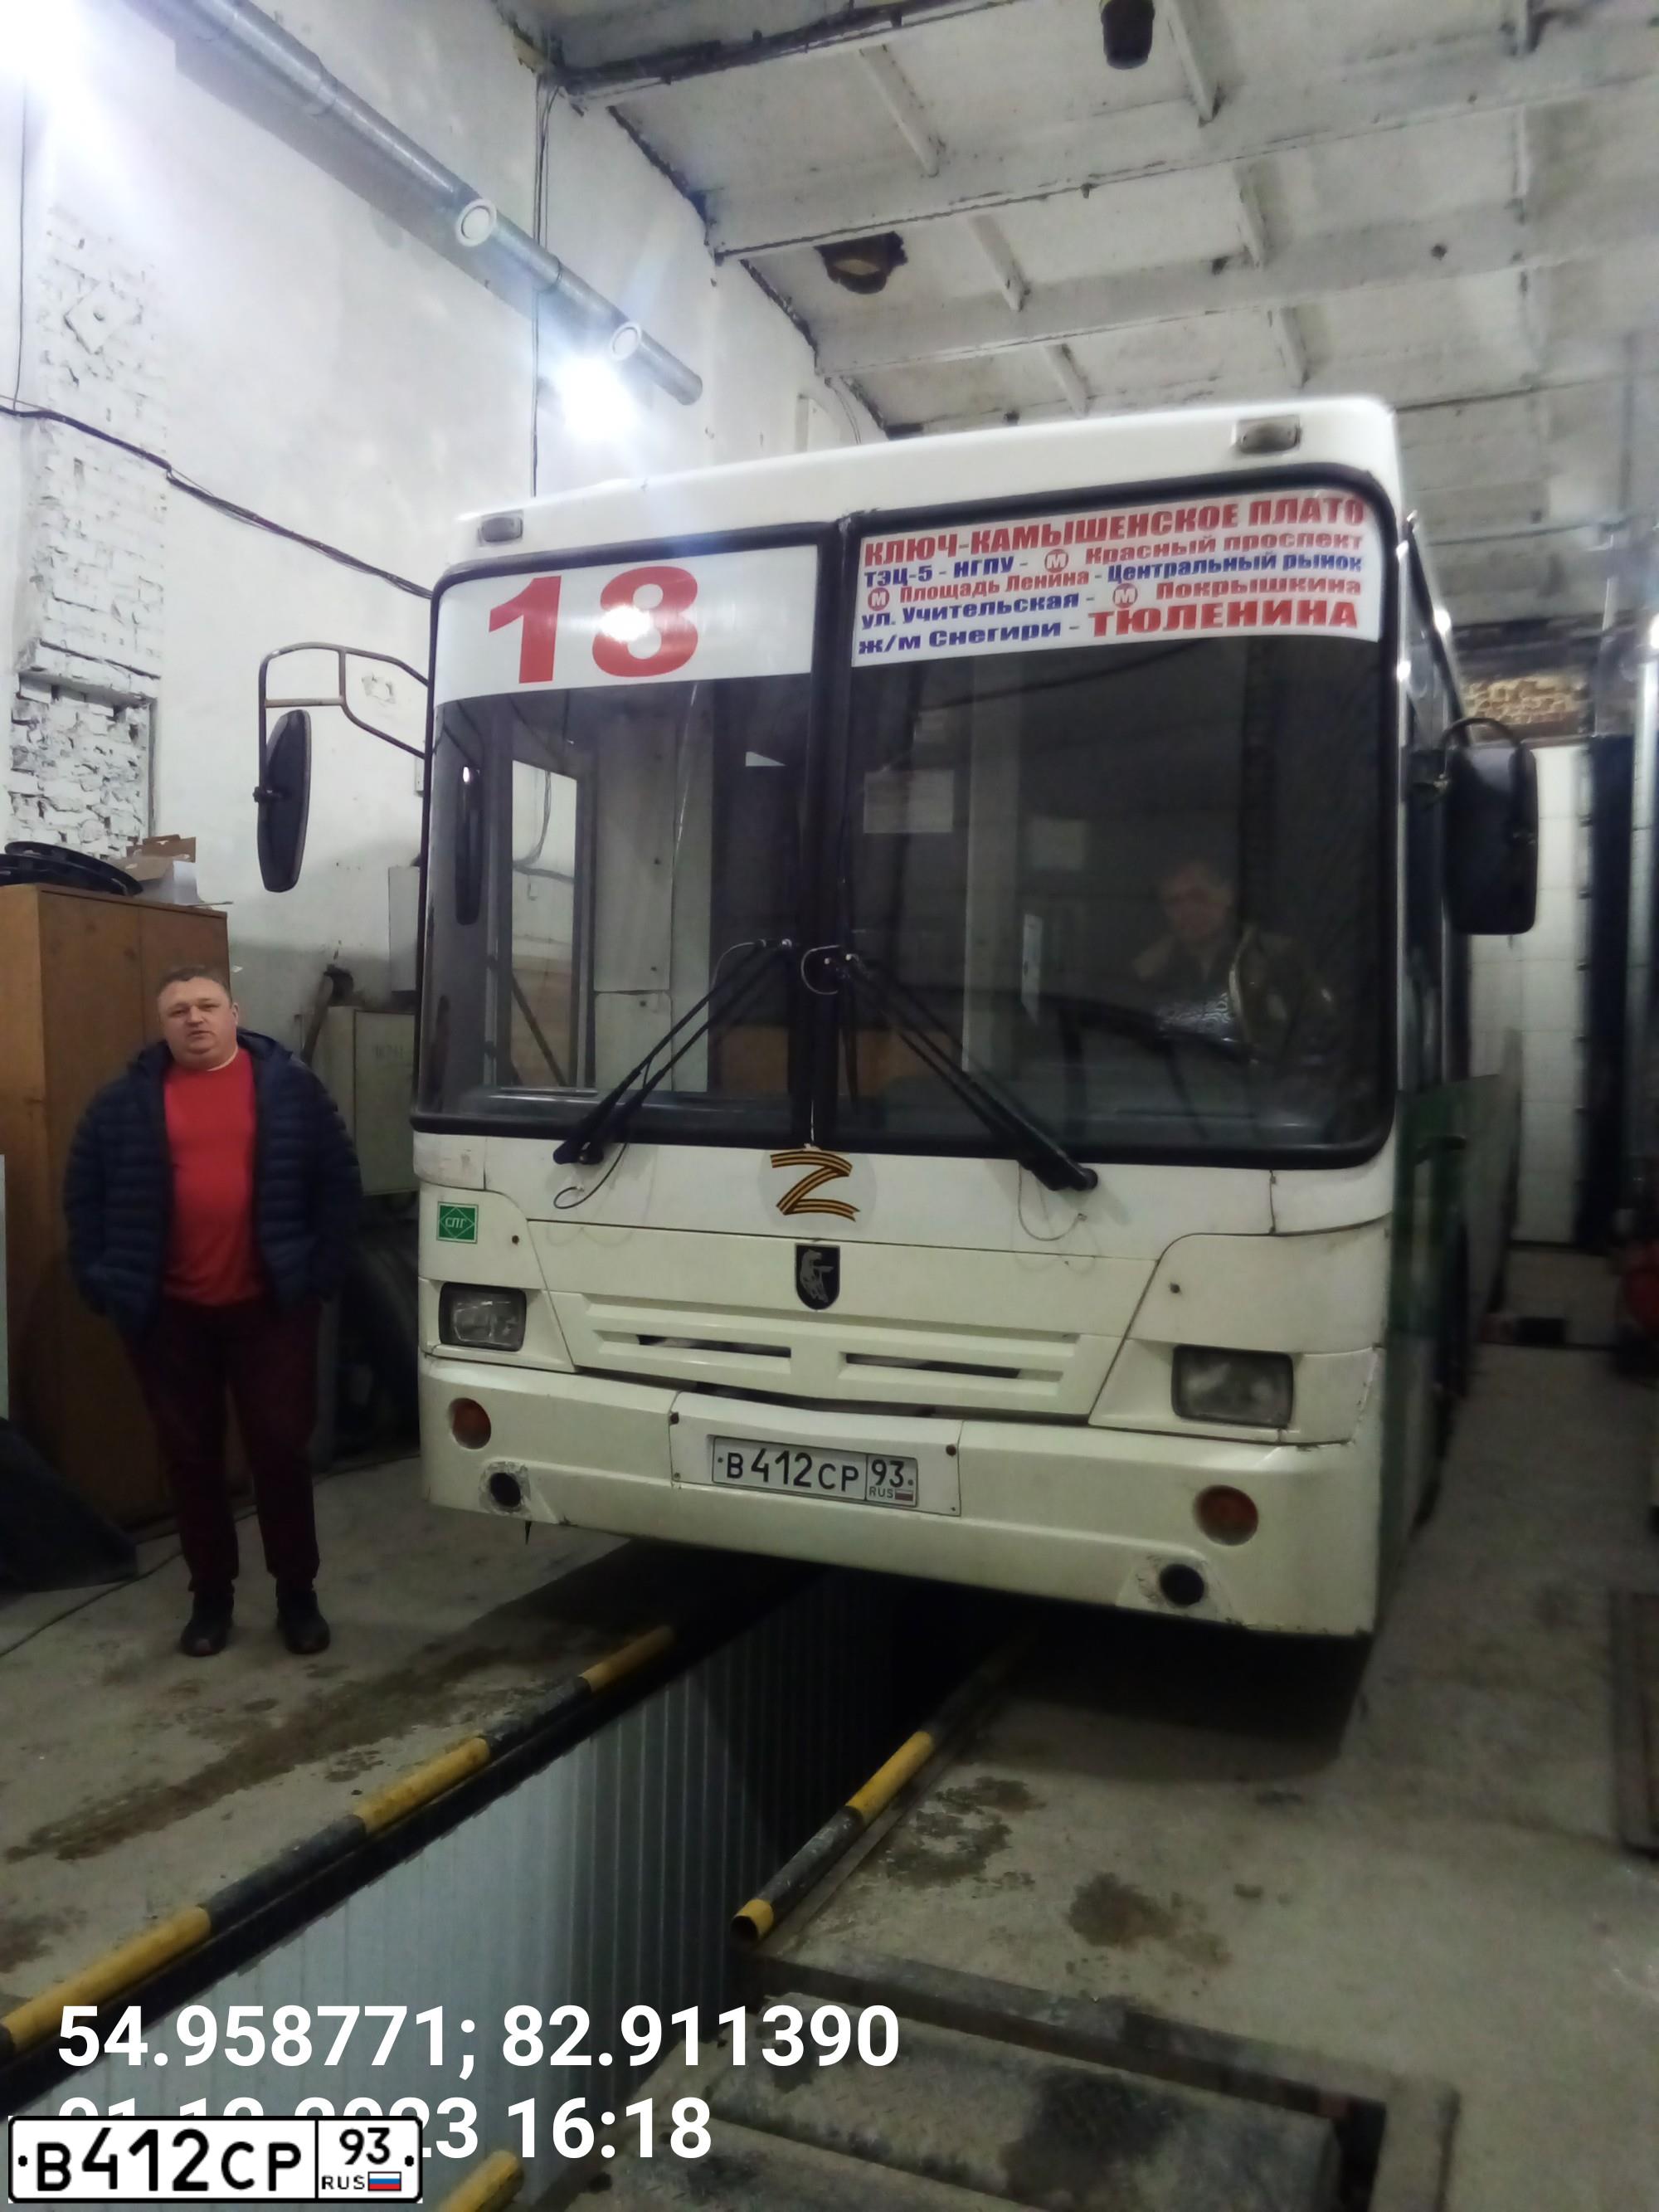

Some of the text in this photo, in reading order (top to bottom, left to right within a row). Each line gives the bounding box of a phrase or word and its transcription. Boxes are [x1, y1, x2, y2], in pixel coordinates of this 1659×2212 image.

[864, 497, 1365, 568] КЛЮЧ-КАМЫШЕНСКОЕ ПЛАТО
[864, 565, 932, 587] ТЭЦ-5
[953, 555, 1014, 578] НГПУ
[1085, 535, 1216, 565] Красный
[1224, 532, 1364, 552] проспект
[861, 612, 896, 631] ул.
[902, 592, 1080, 623] Учительская
[1155, 577, 1362, 601] Покрышкина
[900, 582, 1000, 603] Площадь
[1005, 570, 1089, 592] Ленина
[1107, 551, 1277, 582] Центральный
[1283, 553, 1362, 572] рынок
[489, 566, 698, 684] 18
[859, 634, 921, 655] ж/м
[929, 621, 1062, 648] Снегири
[1088, 599, 1359, 638] ТЮЛЕНИНА
[726, 1448, 904, 1492] В412СР 93
[869, 1486, 894, 1499] RUS
